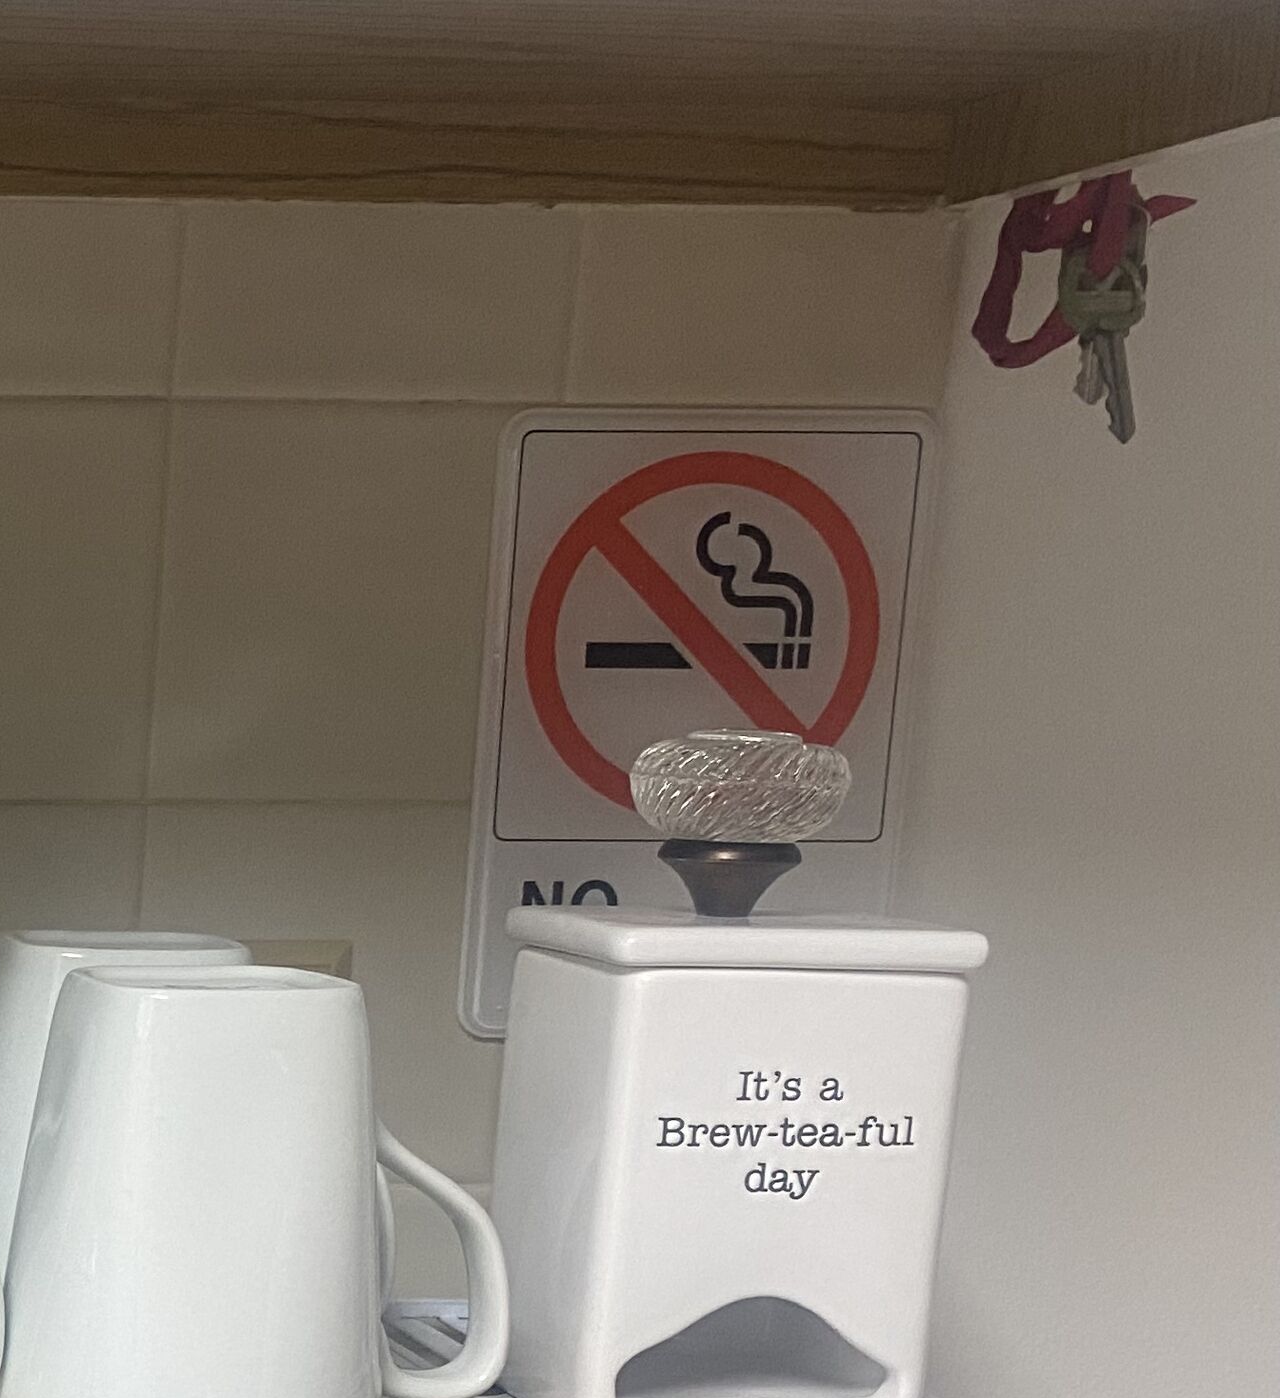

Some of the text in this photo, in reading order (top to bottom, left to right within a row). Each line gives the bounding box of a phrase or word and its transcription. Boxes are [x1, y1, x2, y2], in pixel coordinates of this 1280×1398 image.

[735, 1070, 844, 1101] It's a
[656, 1115, 915, 1148] Brew-tea-ful
[743, 1162, 820, 1200] day
